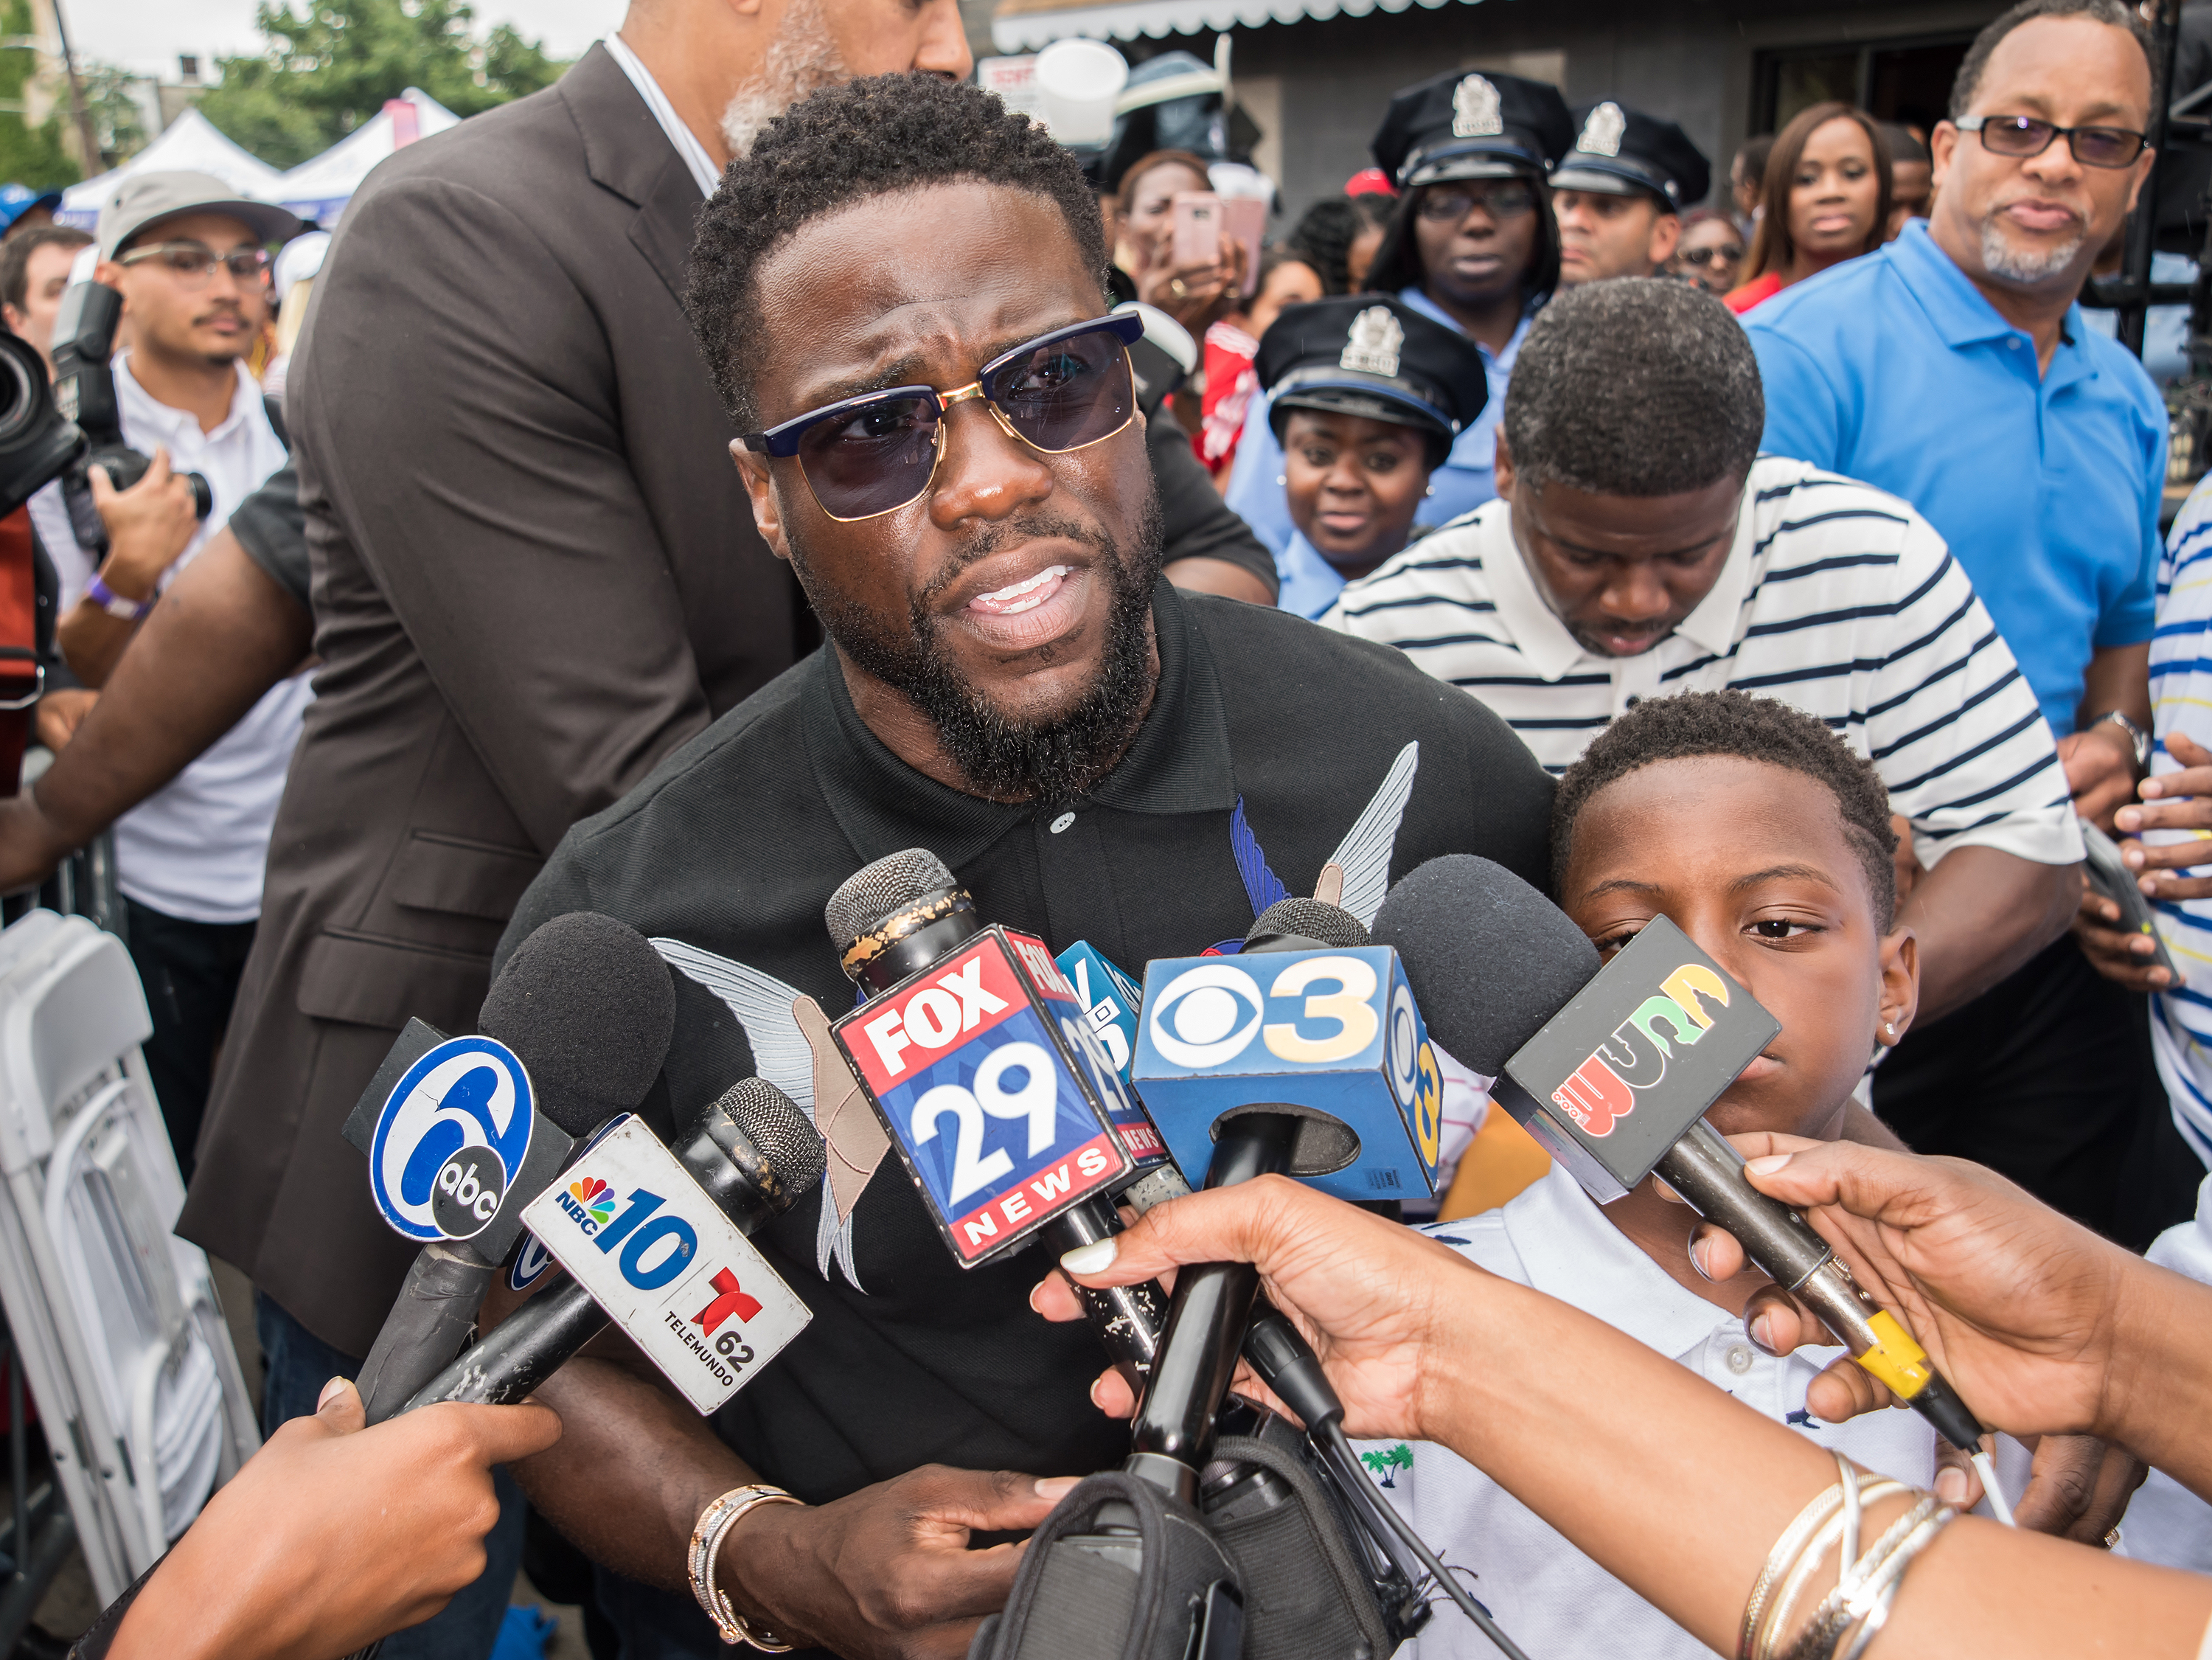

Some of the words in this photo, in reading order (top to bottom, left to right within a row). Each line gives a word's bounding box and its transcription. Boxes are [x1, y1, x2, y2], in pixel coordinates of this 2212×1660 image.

[864, 956, 1009, 1077] FOX
[1014, 940, 1070, 994] FOX
[1263, 956, 1379, 1063] 3
[1060, 1017, 1133, 1110] 29
[1414, 1042, 1440, 1167] 3
[381, 1052, 516, 1232] 6
[911, 1041, 1058, 1208] 29
[1123, 1128, 1160, 1151] NEWS
[439, 1160, 497, 1219] abc
[963, 1147, 1107, 1246] NEWS
[555, 1190, 598, 1236] NBC
[593, 1188, 698, 1291] 10
[664, 1311, 734, 1387] TELEMUNDO
[715, 1331, 755, 1373] 62
